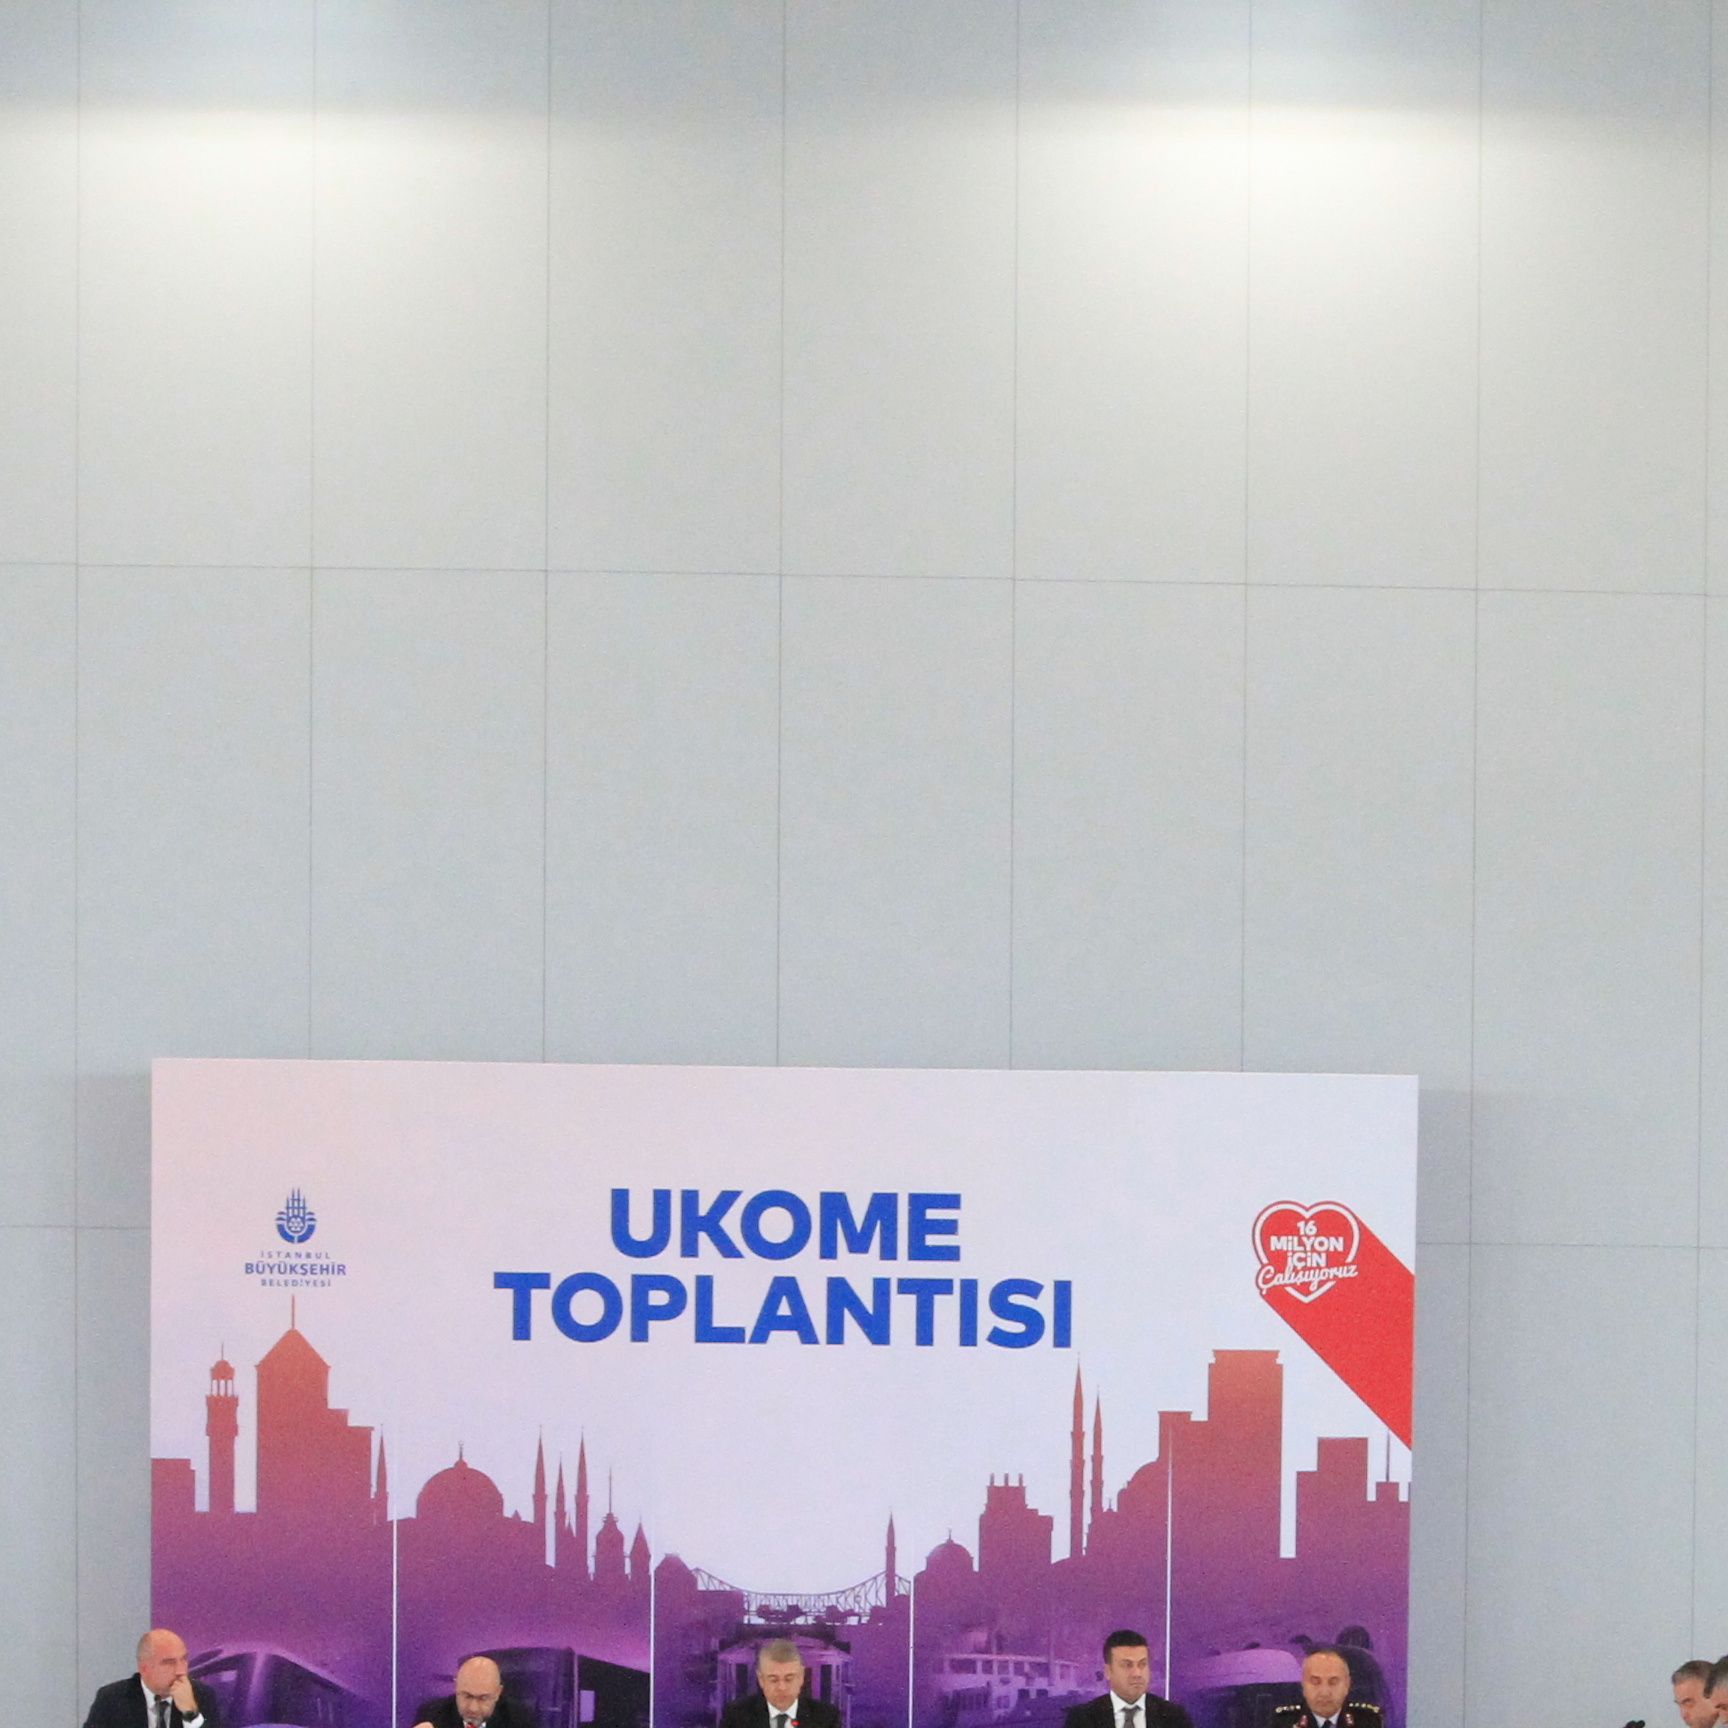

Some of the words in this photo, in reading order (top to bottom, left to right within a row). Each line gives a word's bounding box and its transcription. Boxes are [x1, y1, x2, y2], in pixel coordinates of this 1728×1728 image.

[610, 1187, 962, 1262] UKOME
[1297, 1221, 1318, 1235] 16
[245, 1261, 346, 1276] BÜYÜKŞEHİR
[493, 1271, 1072, 1349] TOPLANTISI
